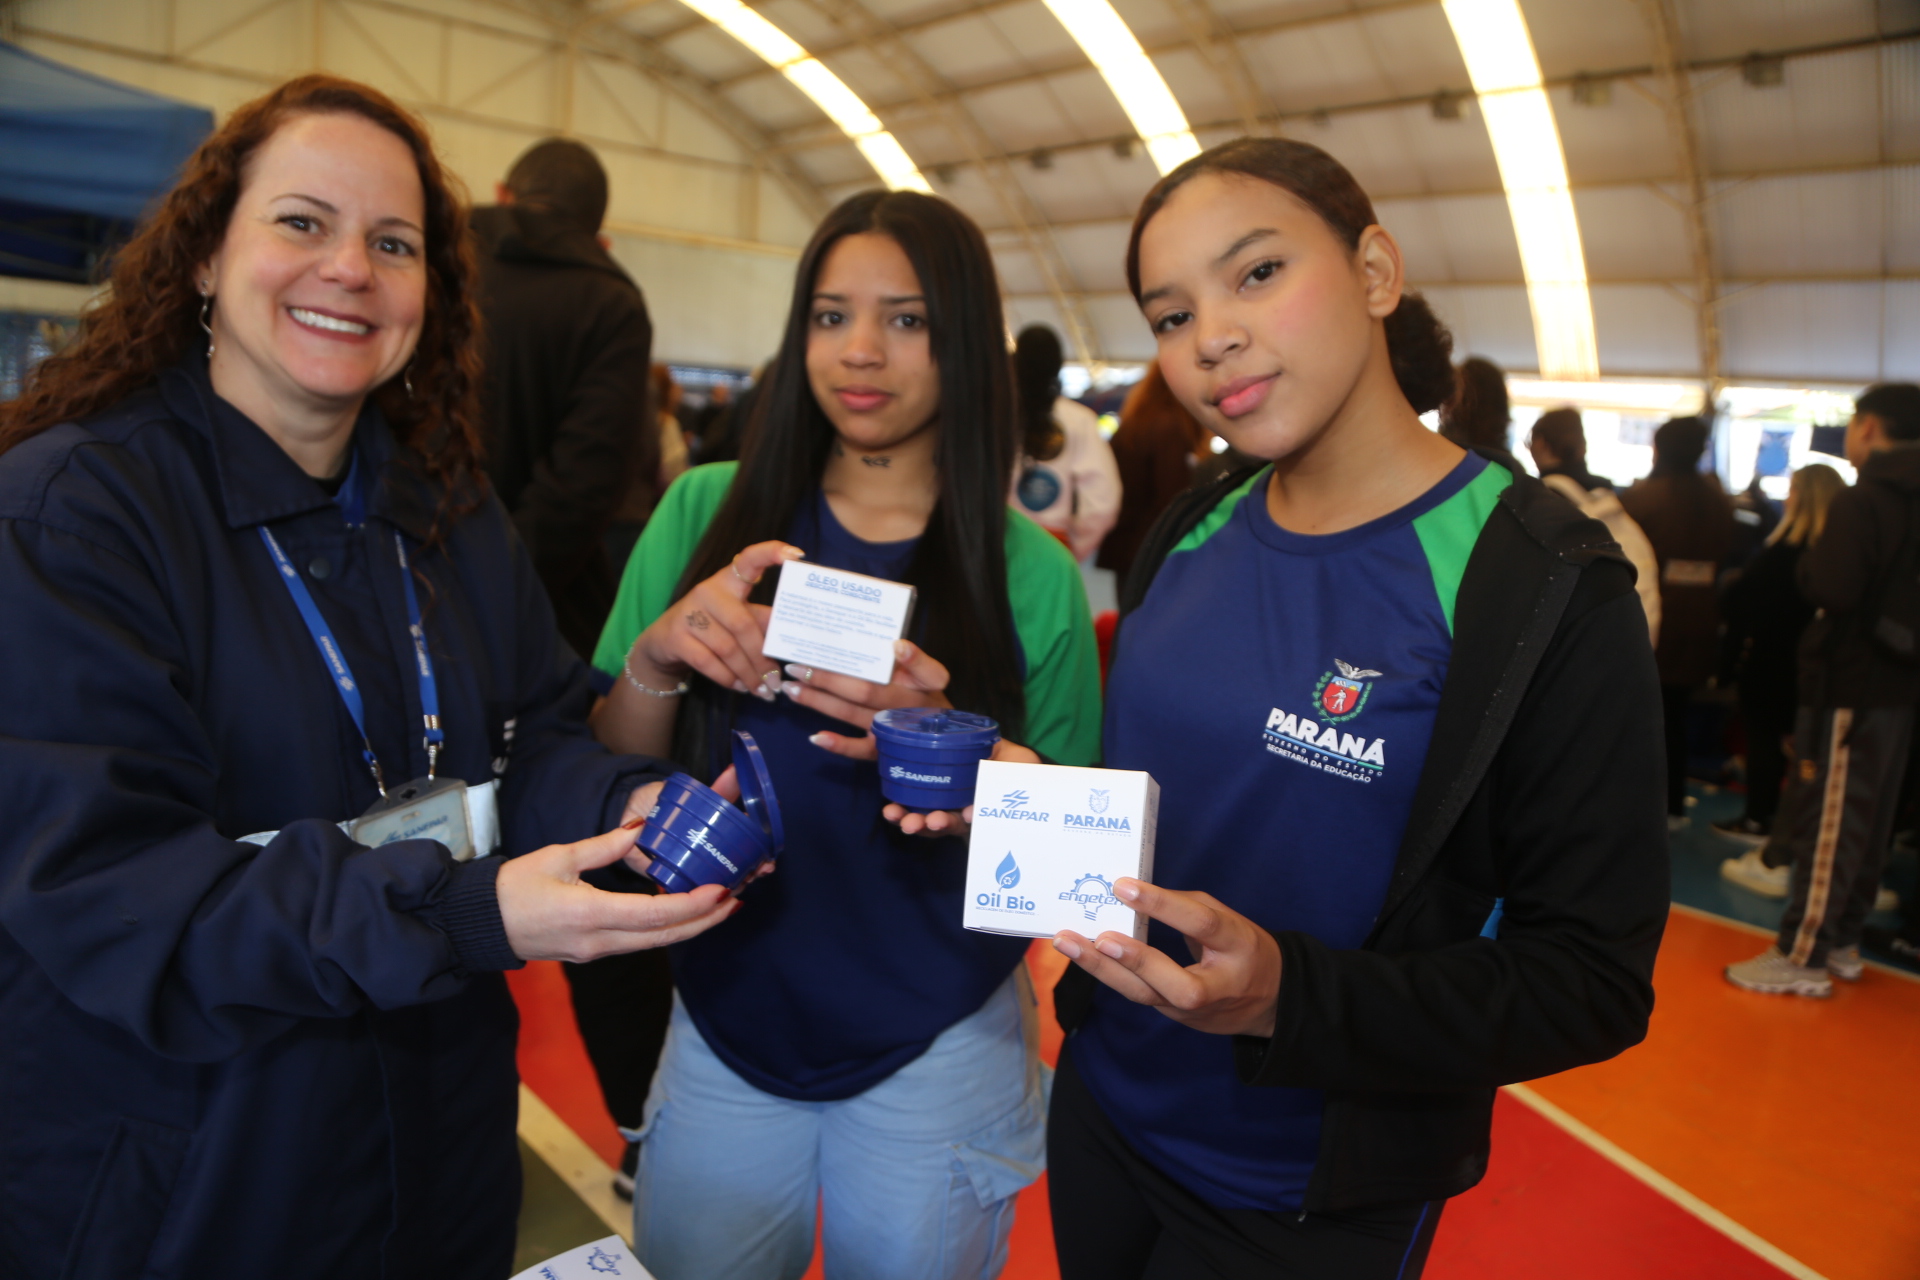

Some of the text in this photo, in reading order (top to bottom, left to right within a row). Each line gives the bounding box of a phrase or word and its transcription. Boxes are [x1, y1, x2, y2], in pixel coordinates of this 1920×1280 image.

[808, 571, 882, 598] ÓLEO USADO
[1266, 707, 1386, 766] PARANÁ
[1262, 733, 1383, 777] GOVERNO DO ESTADO
[1266, 742, 1372, 784] SECRETARIA DA EDUCAÇÃO
[905, 771, 952, 784] SANEPAR
[979, 807, 1050, 822] SANEPAR
[1064, 814, 1131, 830] PARANÁ
[703, 842, 739, 875] SANEPAR
[976, 893, 1036, 912] Oil Bio
